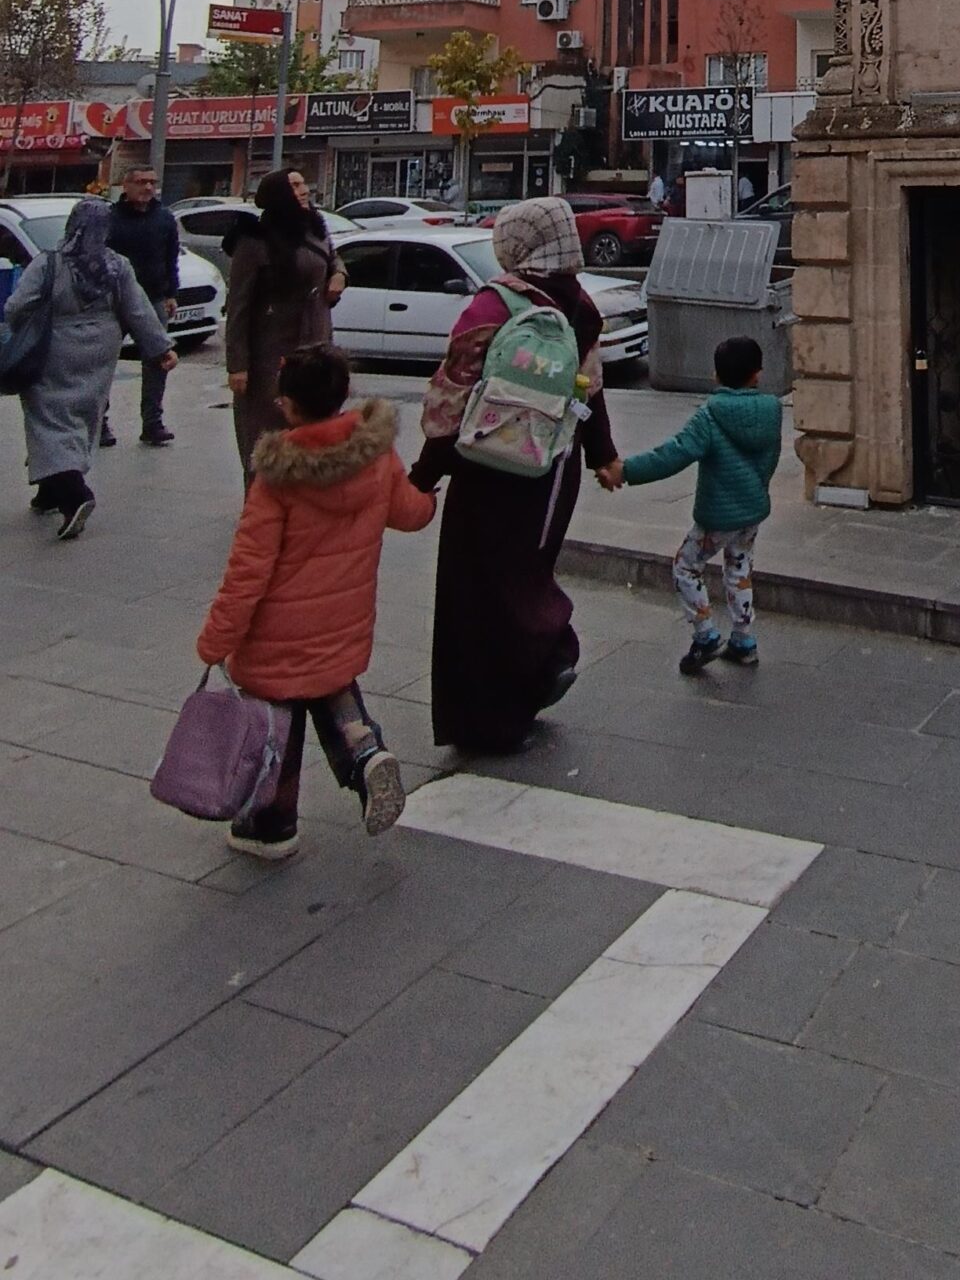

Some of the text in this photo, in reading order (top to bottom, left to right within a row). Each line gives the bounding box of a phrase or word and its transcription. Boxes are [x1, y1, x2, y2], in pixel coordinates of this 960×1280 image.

[212, 9, 249, 22] SANAT
[310, 101, 350, 116] ALTUN
[148, 111, 199, 124] SRHAT
[664, 113, 727, 128] MUSTAFA
